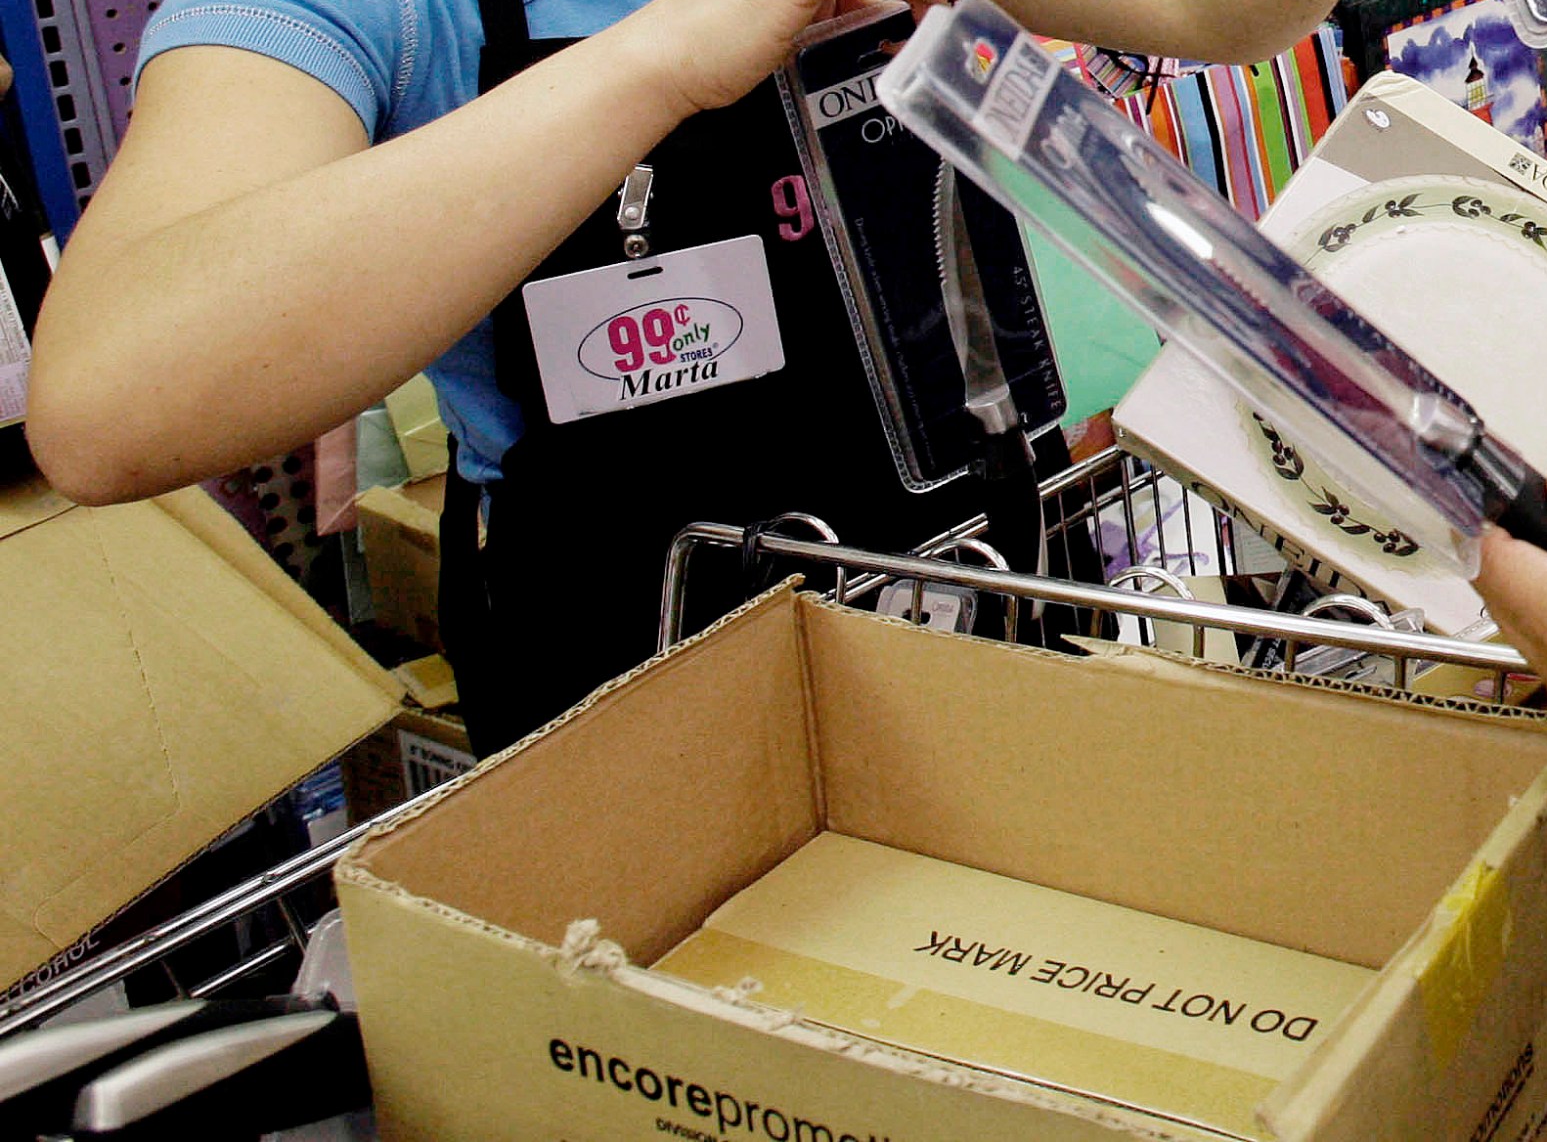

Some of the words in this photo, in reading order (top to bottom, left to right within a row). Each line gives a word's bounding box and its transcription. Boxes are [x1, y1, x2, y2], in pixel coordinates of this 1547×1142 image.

[672, 323, 711, 352] only
[1020, 295, 1045, 350] STEAK
[1038, 357, 1062, 408] KNIFE
[618, 359, 719, 401] Marta
[912, 929, 1034, 977] MARK
[1029, 958, 1156, 1007] PRICE
[1151, 988, 1248, 1027] NOT
[1249, 1008, 1319, 1043] DO
